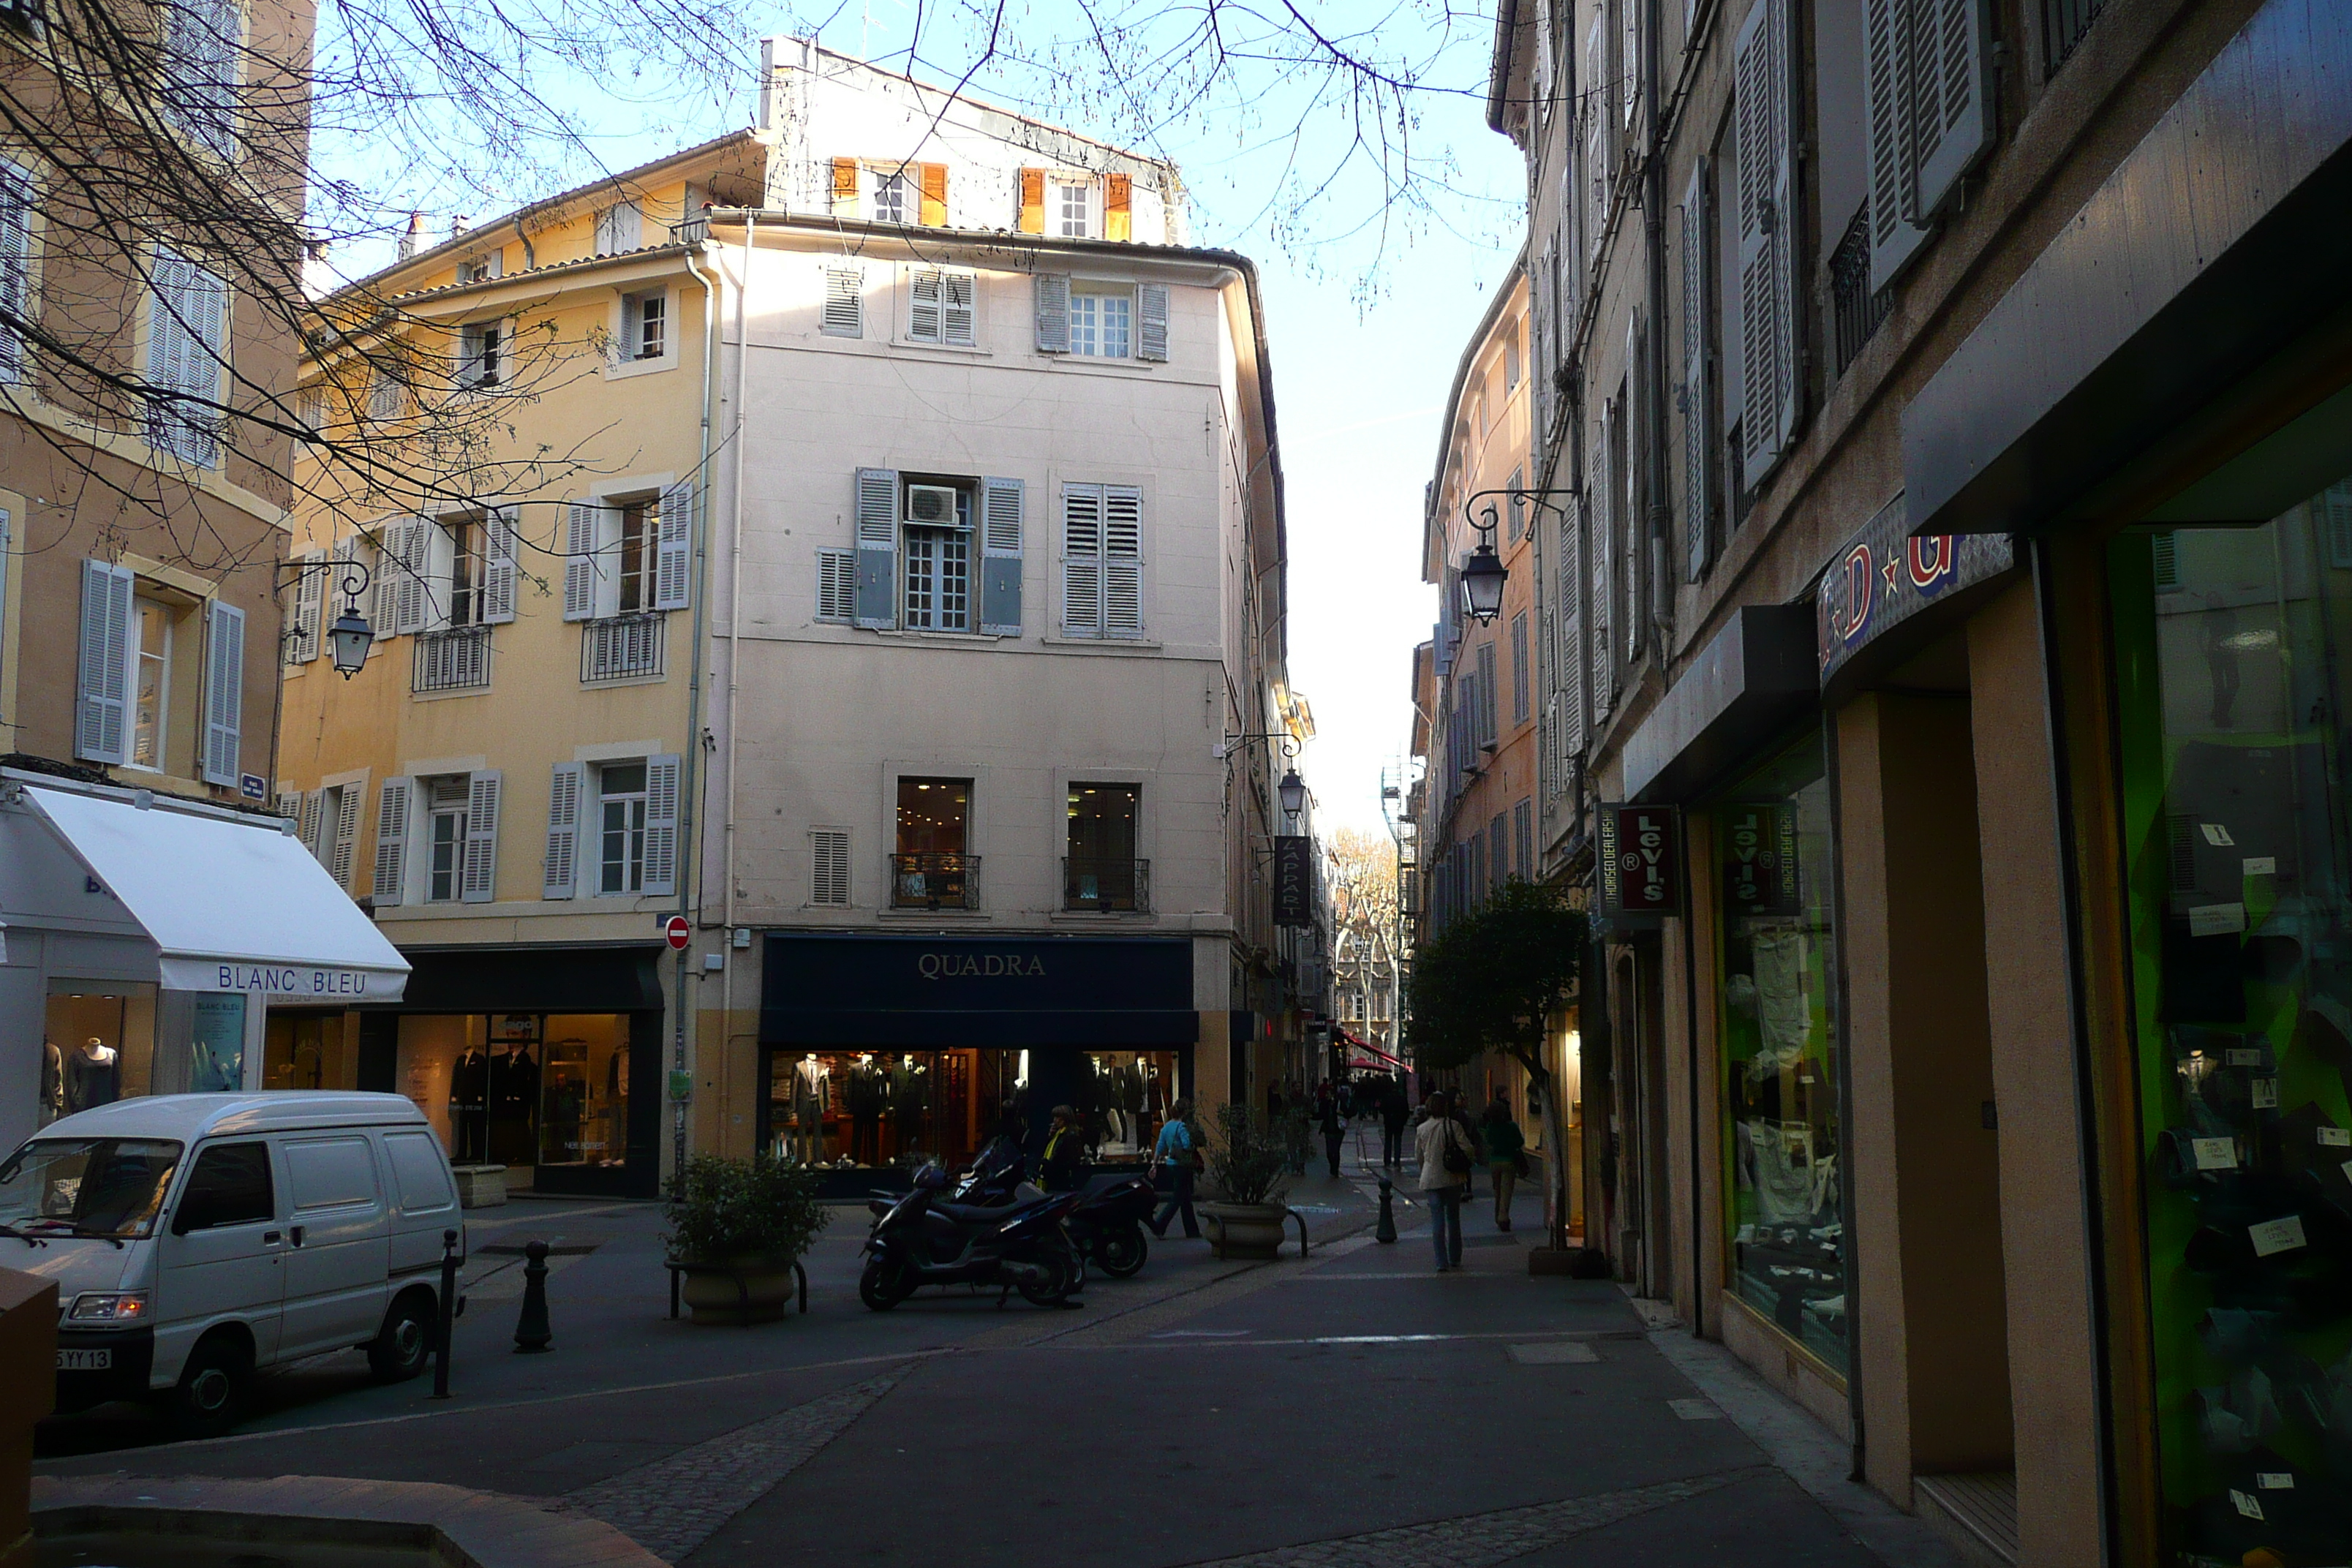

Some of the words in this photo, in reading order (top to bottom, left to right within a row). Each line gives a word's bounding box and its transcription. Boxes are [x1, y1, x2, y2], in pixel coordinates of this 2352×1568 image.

[1283, 840, 1304, 916] L'APPART
[219, 966, 295, 991] BLANC
[314, 972, 365, 994] BLEU
[918, 954, 1047, 980] QUADRA
[90, 1352, 107, 1367] 13
